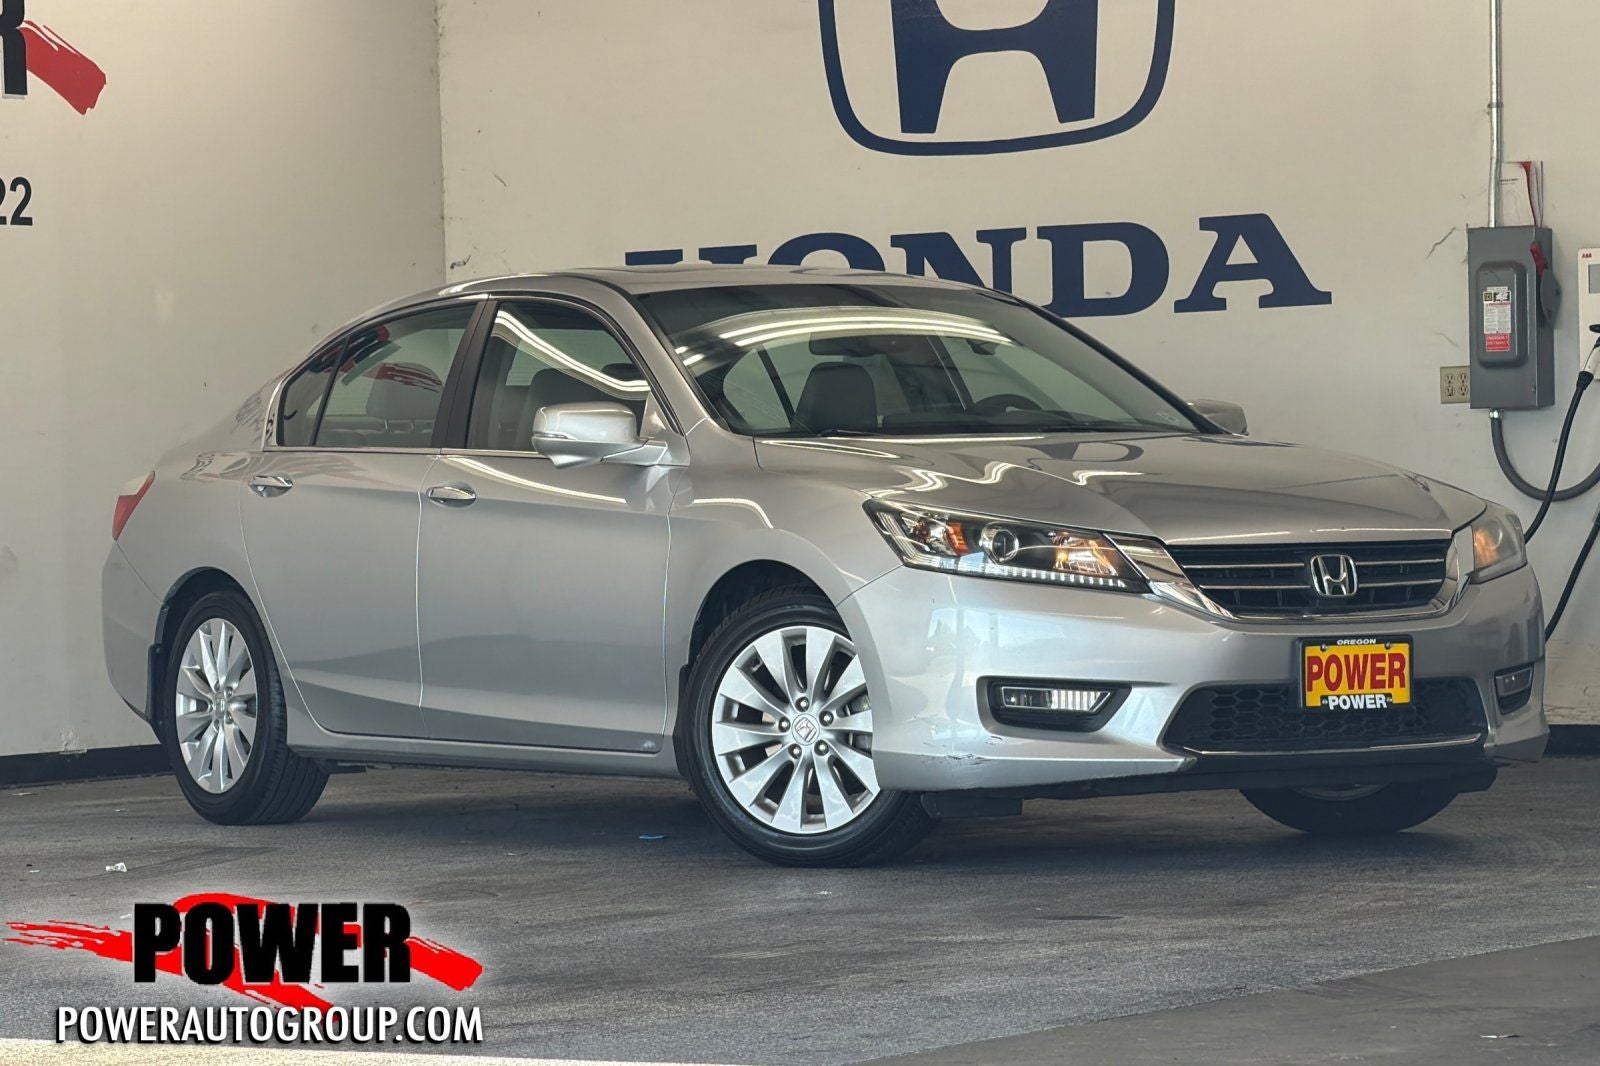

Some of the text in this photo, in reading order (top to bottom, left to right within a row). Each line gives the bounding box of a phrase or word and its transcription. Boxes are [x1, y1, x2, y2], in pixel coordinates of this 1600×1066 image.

[625, 213, 1332, 319] NDA
[1336, 638, 1377, 646] OREGON
[1306, 652, 1407, 692] POWER
[1327, 693, 1388, 711] POWER
